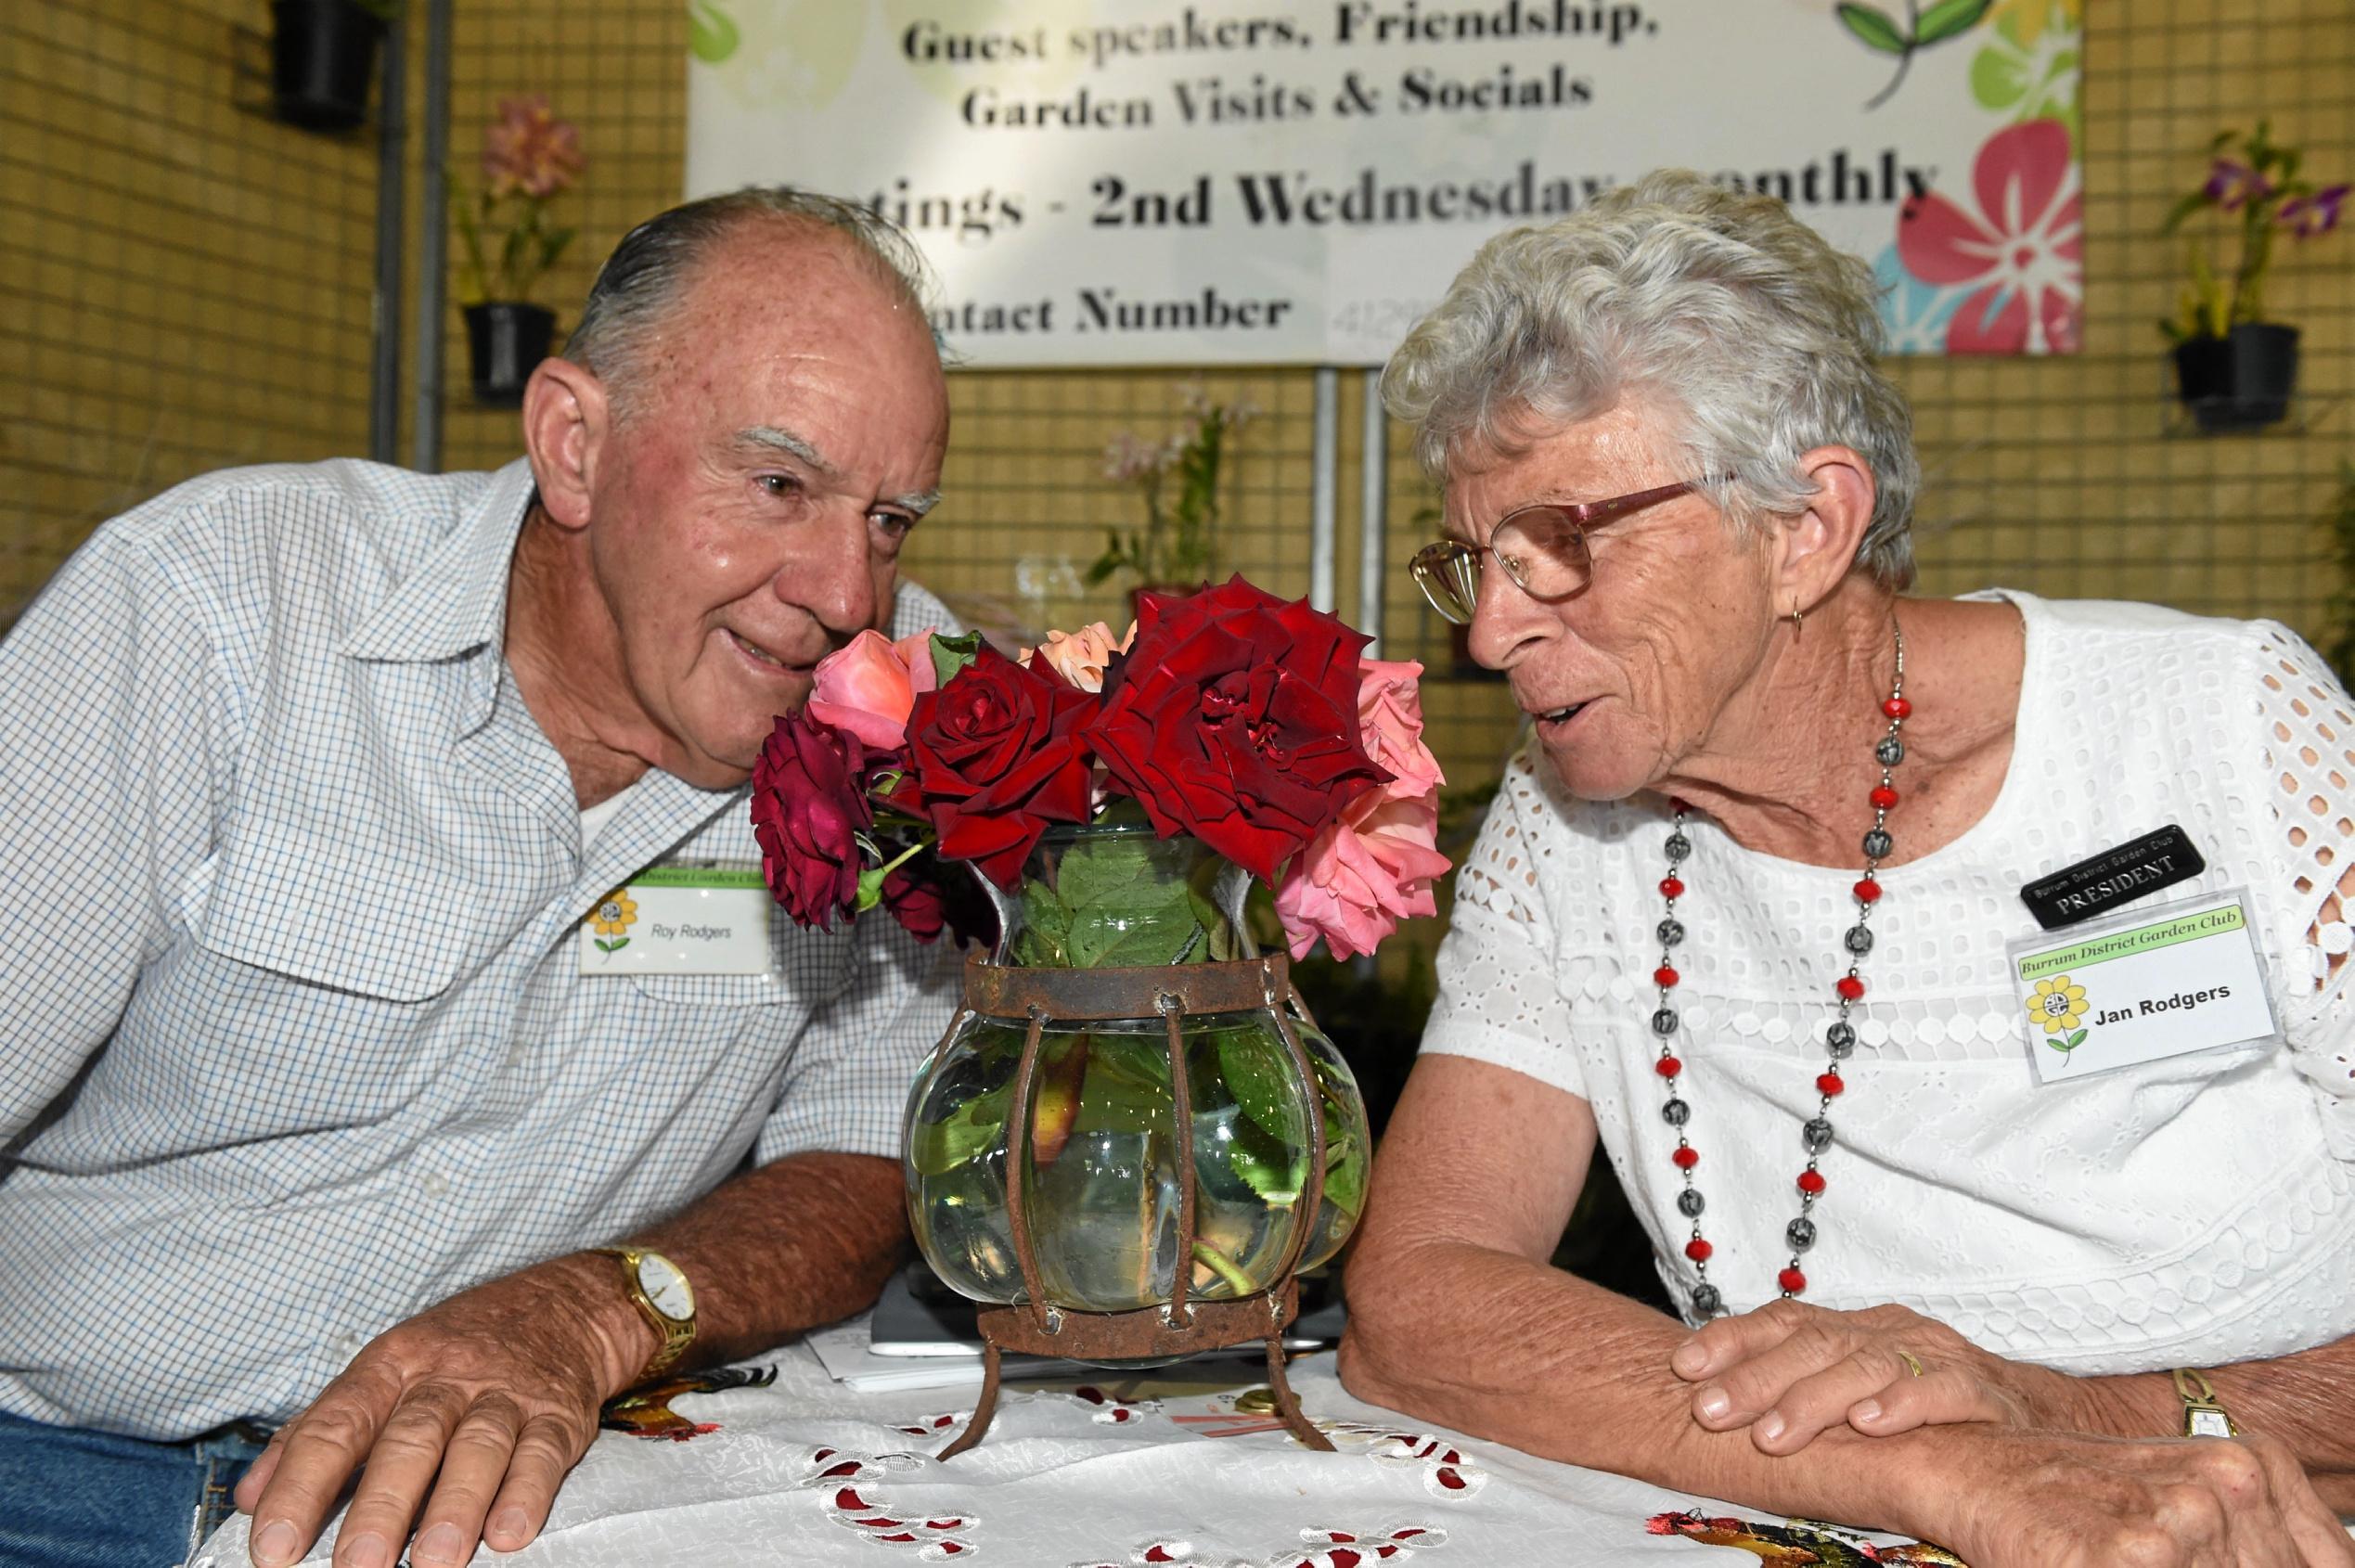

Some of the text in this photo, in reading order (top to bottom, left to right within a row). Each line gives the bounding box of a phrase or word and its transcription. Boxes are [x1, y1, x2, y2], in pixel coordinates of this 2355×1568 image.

[903, 19, 1049, 65] Guest
[961, 64, 1593, 131] Garden Visits & Socials
[1089, 174, 1210, 227] 2nd
[1710, 147, 1939, 221] onthly
[932, 299, 1054, 335] ntact
[1074, 288, 1293, 335] Number
[2149, 835, 2174, 851] Club
[2056, 855, 2175, 915] PRESIDENT
[650, 923, 732, 942] Roy Rodgers
[2021, 911, 2237, 975] Burrum District Garden Club
[2094, 984, 2232, 1026] Jan Rodgers
